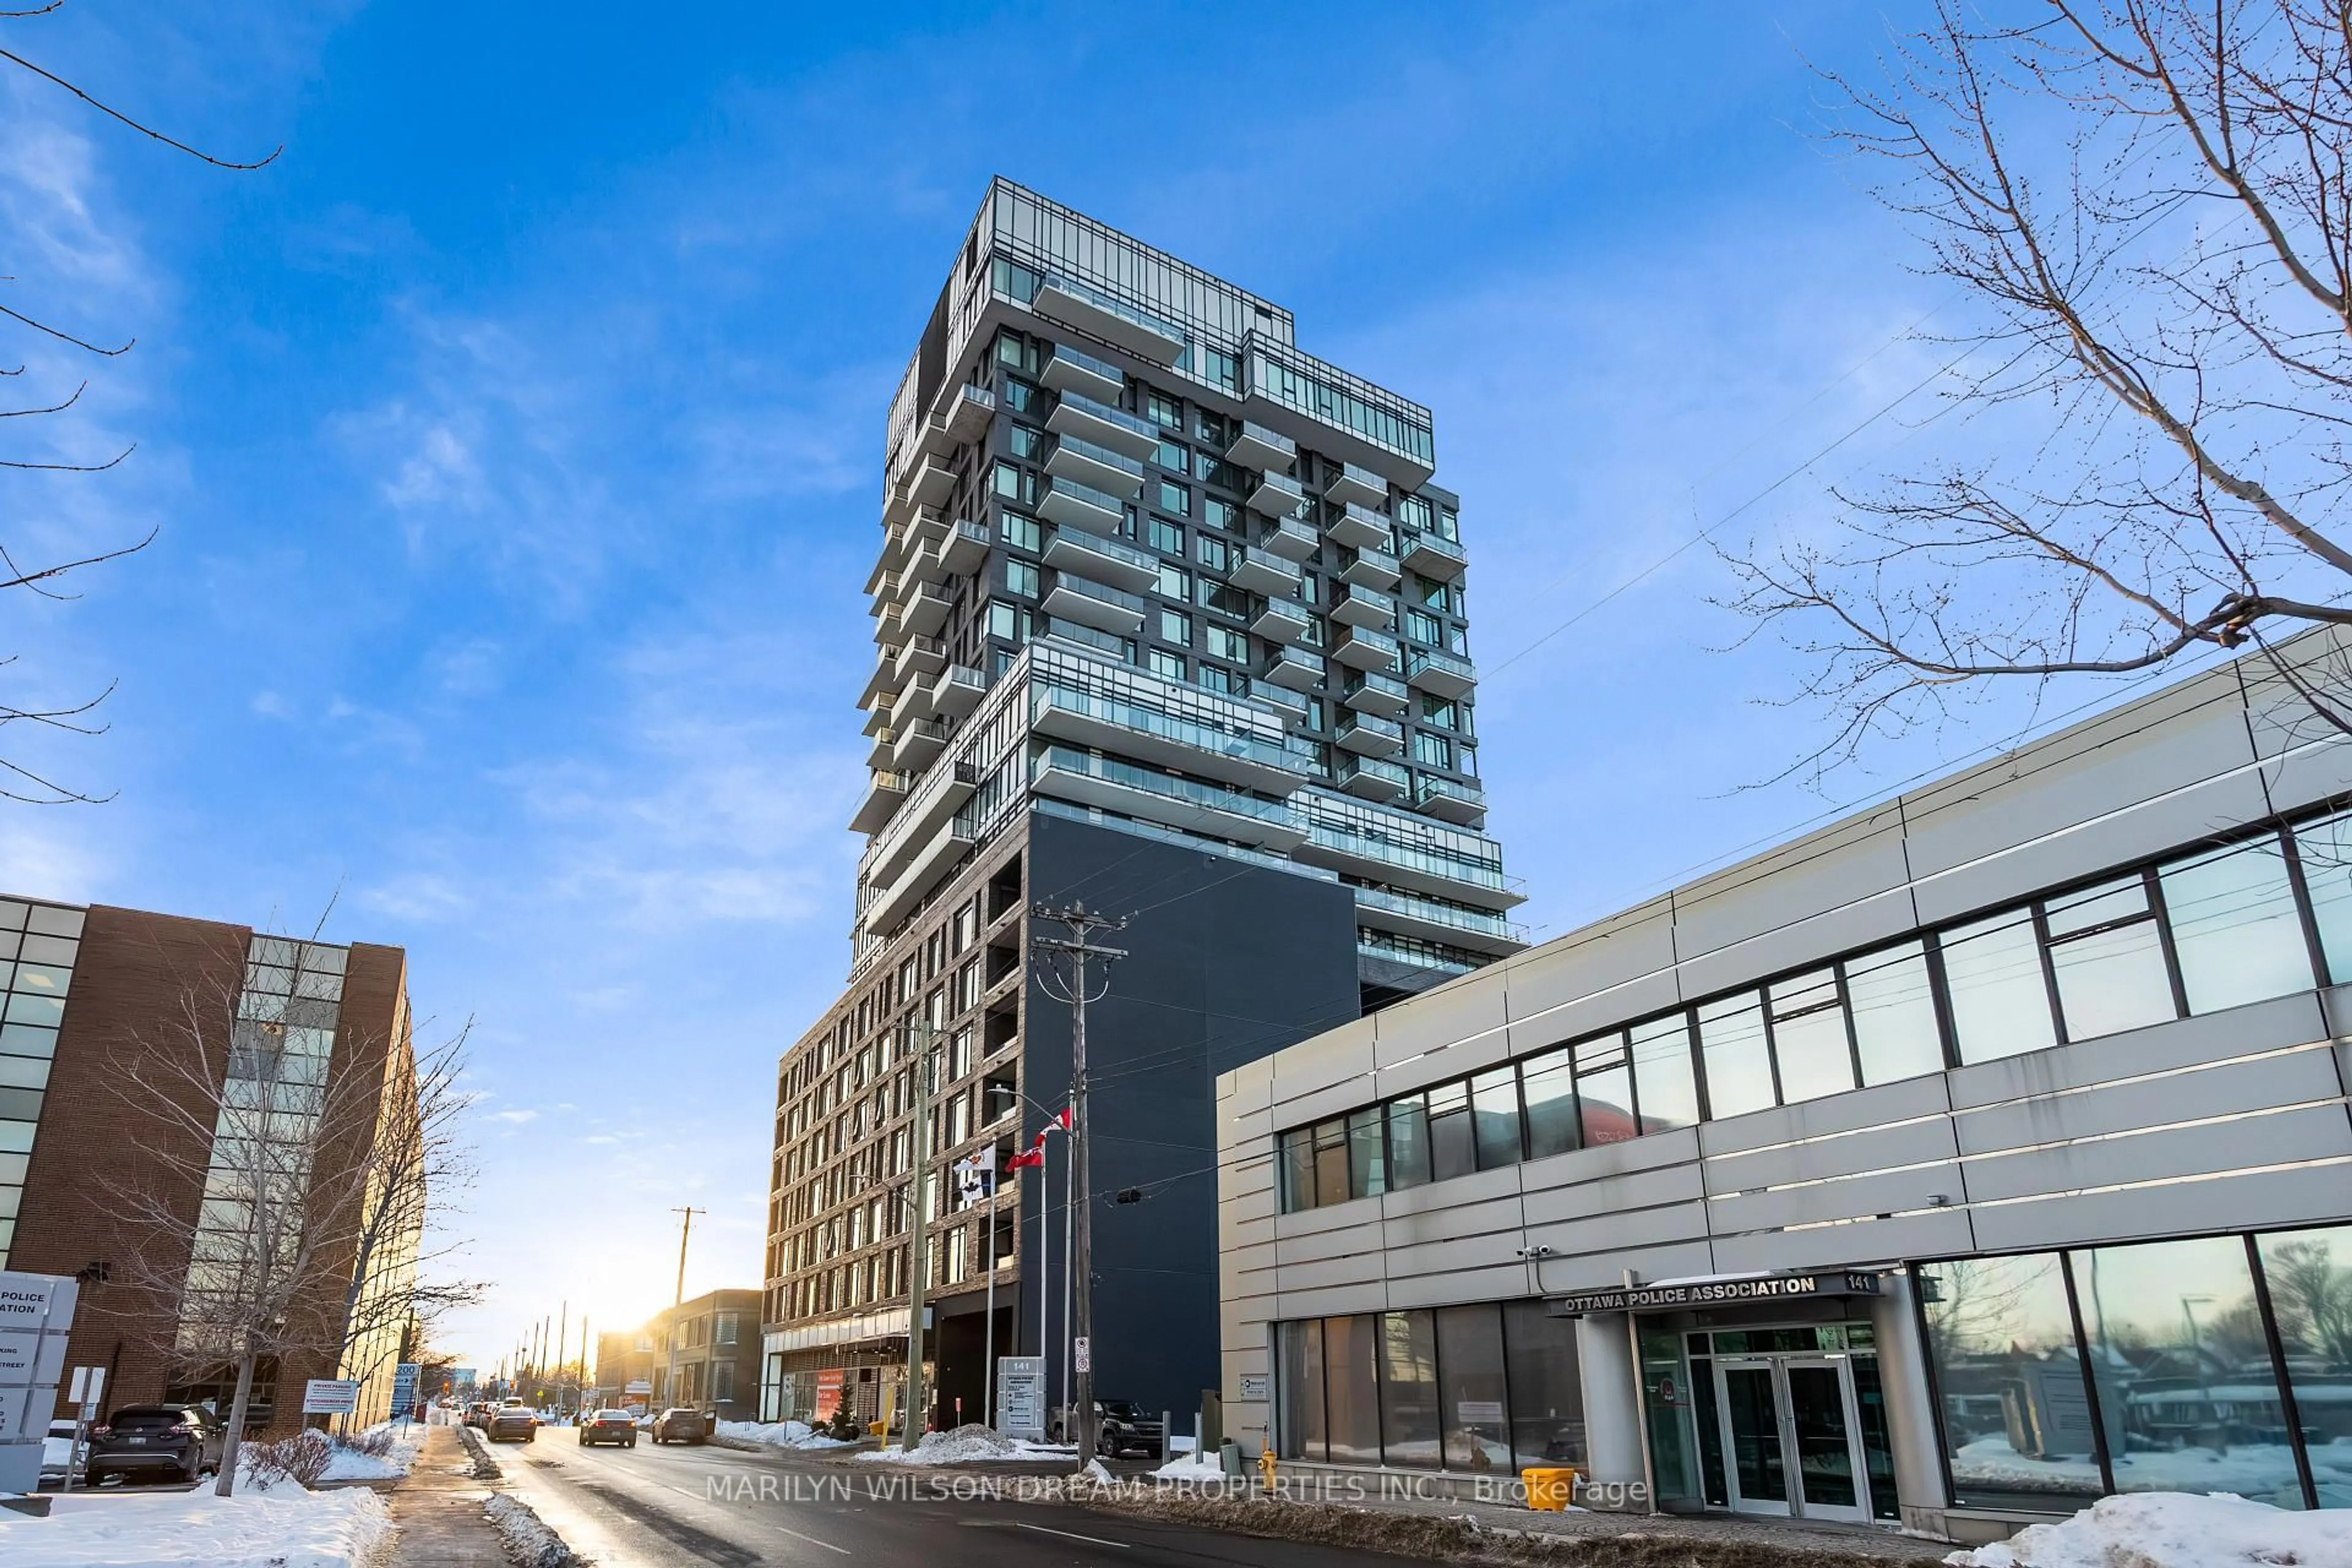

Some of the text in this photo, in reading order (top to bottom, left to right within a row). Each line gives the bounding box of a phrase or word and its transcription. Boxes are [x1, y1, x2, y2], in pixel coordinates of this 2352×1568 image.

[1849, 1275, 1870, 1290] 141
[1, 1292, 45, 1302] POLICE
[1565, 1277, 1815, 1311] OTTAWA POLICE ASSOCIATION
[1014, 1362, 1029, 1371] 141
